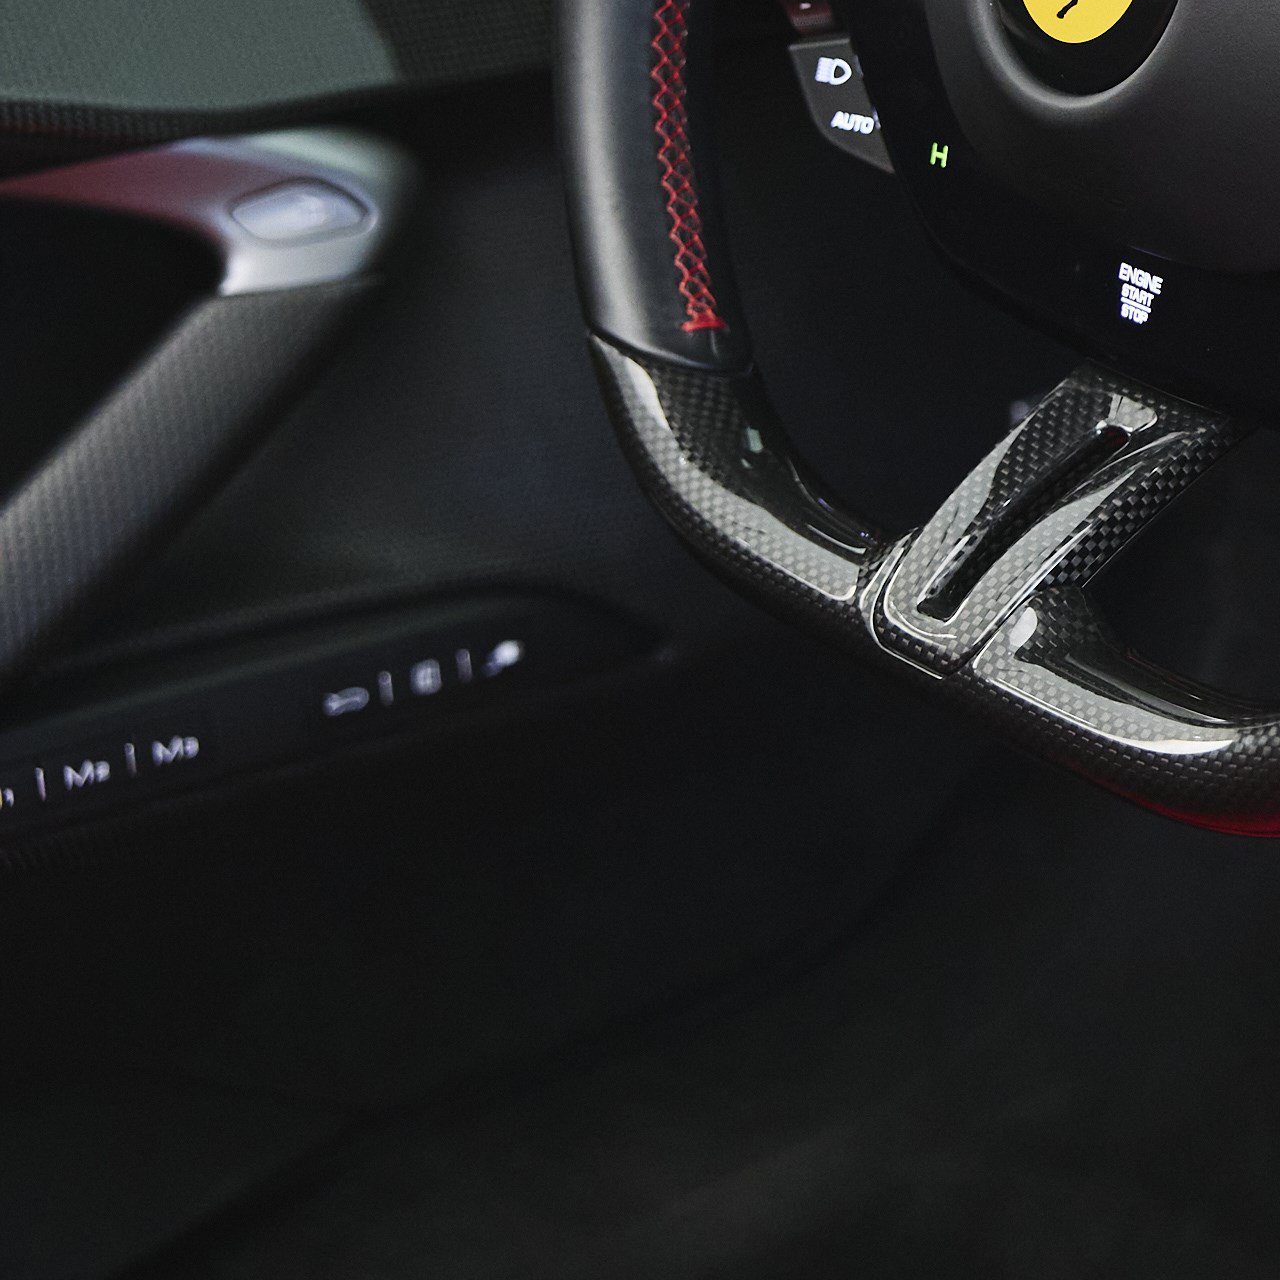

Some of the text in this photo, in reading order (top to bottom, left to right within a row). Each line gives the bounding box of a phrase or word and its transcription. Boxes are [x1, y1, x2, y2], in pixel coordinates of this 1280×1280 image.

[831, 110, 875, 134] AUTO
[930, 142, 949, 168] H
[1119, 262, 1164, 295] ENGINE
[1121, 283, 1155, 307] START
[1121, 303, 1149, 325] STOP
